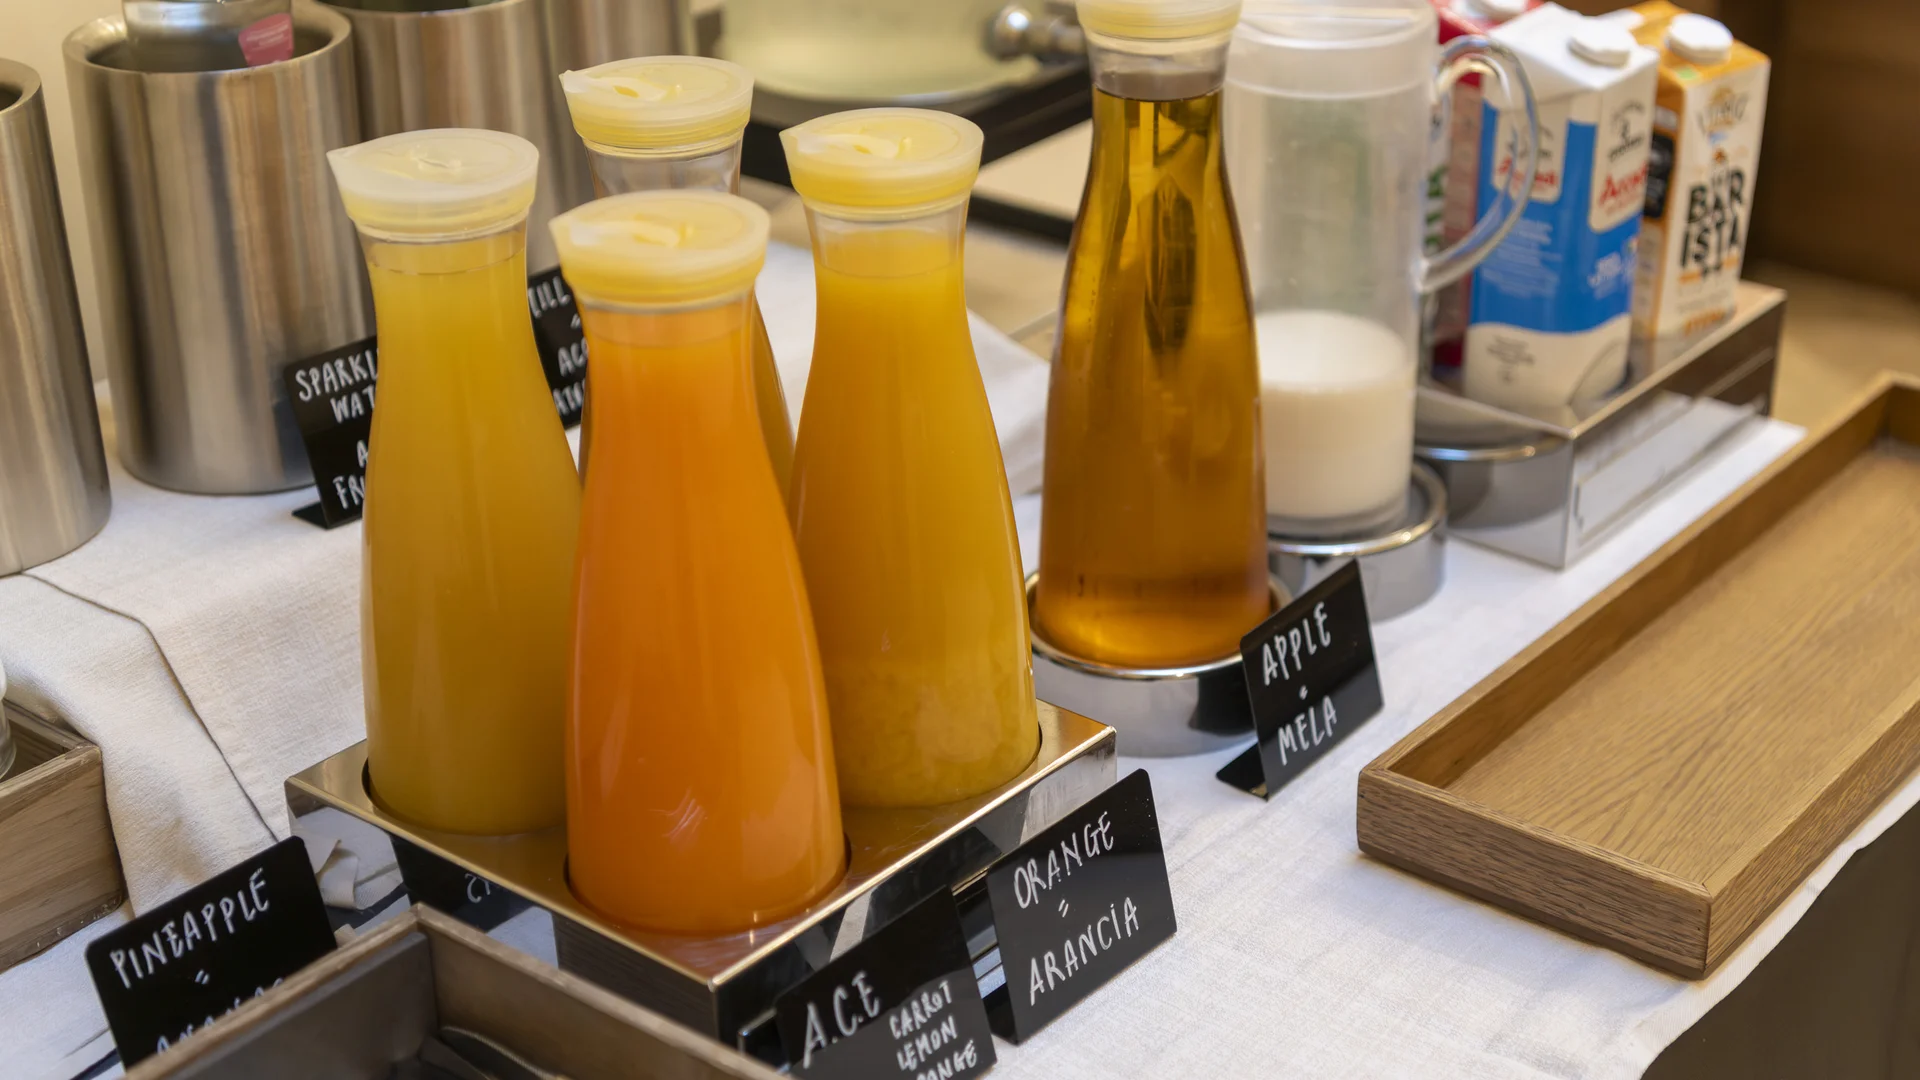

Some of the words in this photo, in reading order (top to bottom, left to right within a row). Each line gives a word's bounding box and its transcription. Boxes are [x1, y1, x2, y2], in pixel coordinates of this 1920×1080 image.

[527, 275, 571, 319] TILL
[295, 348, 379, 402] SPARKL
[330, 384, 376, 424] WAT
[1262, 601, 1331, 686] APPLE
[1277, 695, 1337, 766] MELA
[1013, 811, 1115, 910] ORANGE
[109, 867, 270, 990] PINEAPPLE
[802, 970, 880, 1069] A.C.E
[889, 980, 952, 1040] CARROT
[896, 1015, 958, 1071] LEMON
[916, 1039, 977, 1080] ANGE
